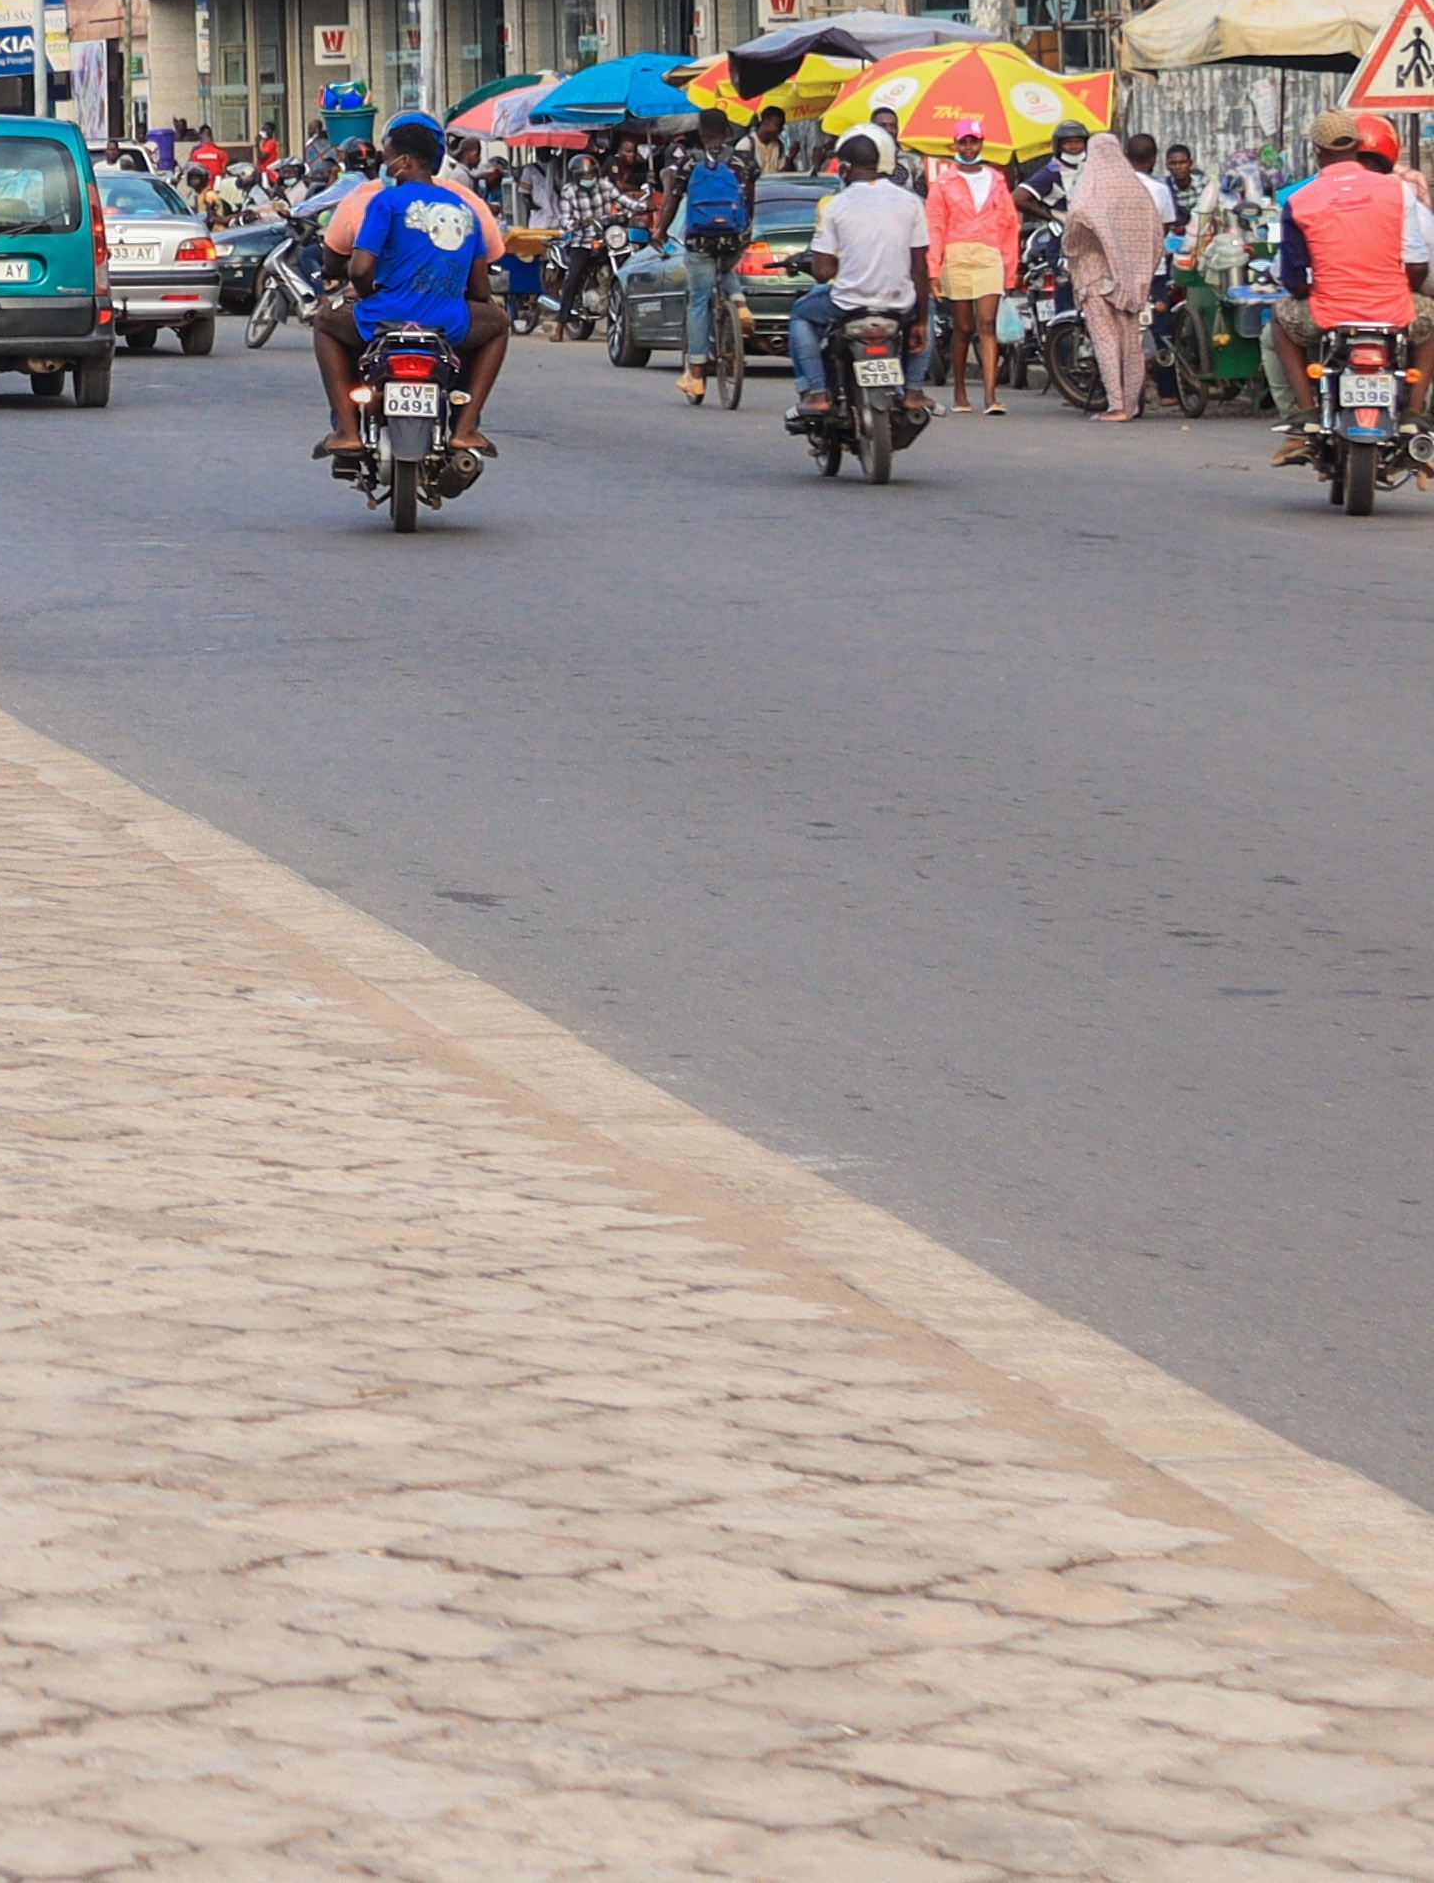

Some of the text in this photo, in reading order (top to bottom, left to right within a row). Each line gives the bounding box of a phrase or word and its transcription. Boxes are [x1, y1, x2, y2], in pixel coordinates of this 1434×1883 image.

[6, 56, 33, 66] People
[136, 246, 152, 259] AY
[5, 263, 25, 276] AY
[866, 360, 886, 373] CB
[861, 372, 900, 384] 5787
[1355, 376, 1379, 390] CW
[399, 385, 423, 399] CV
[1343, 392, 1391, 405] 3396
[388, 400, 434, 415] 0491
